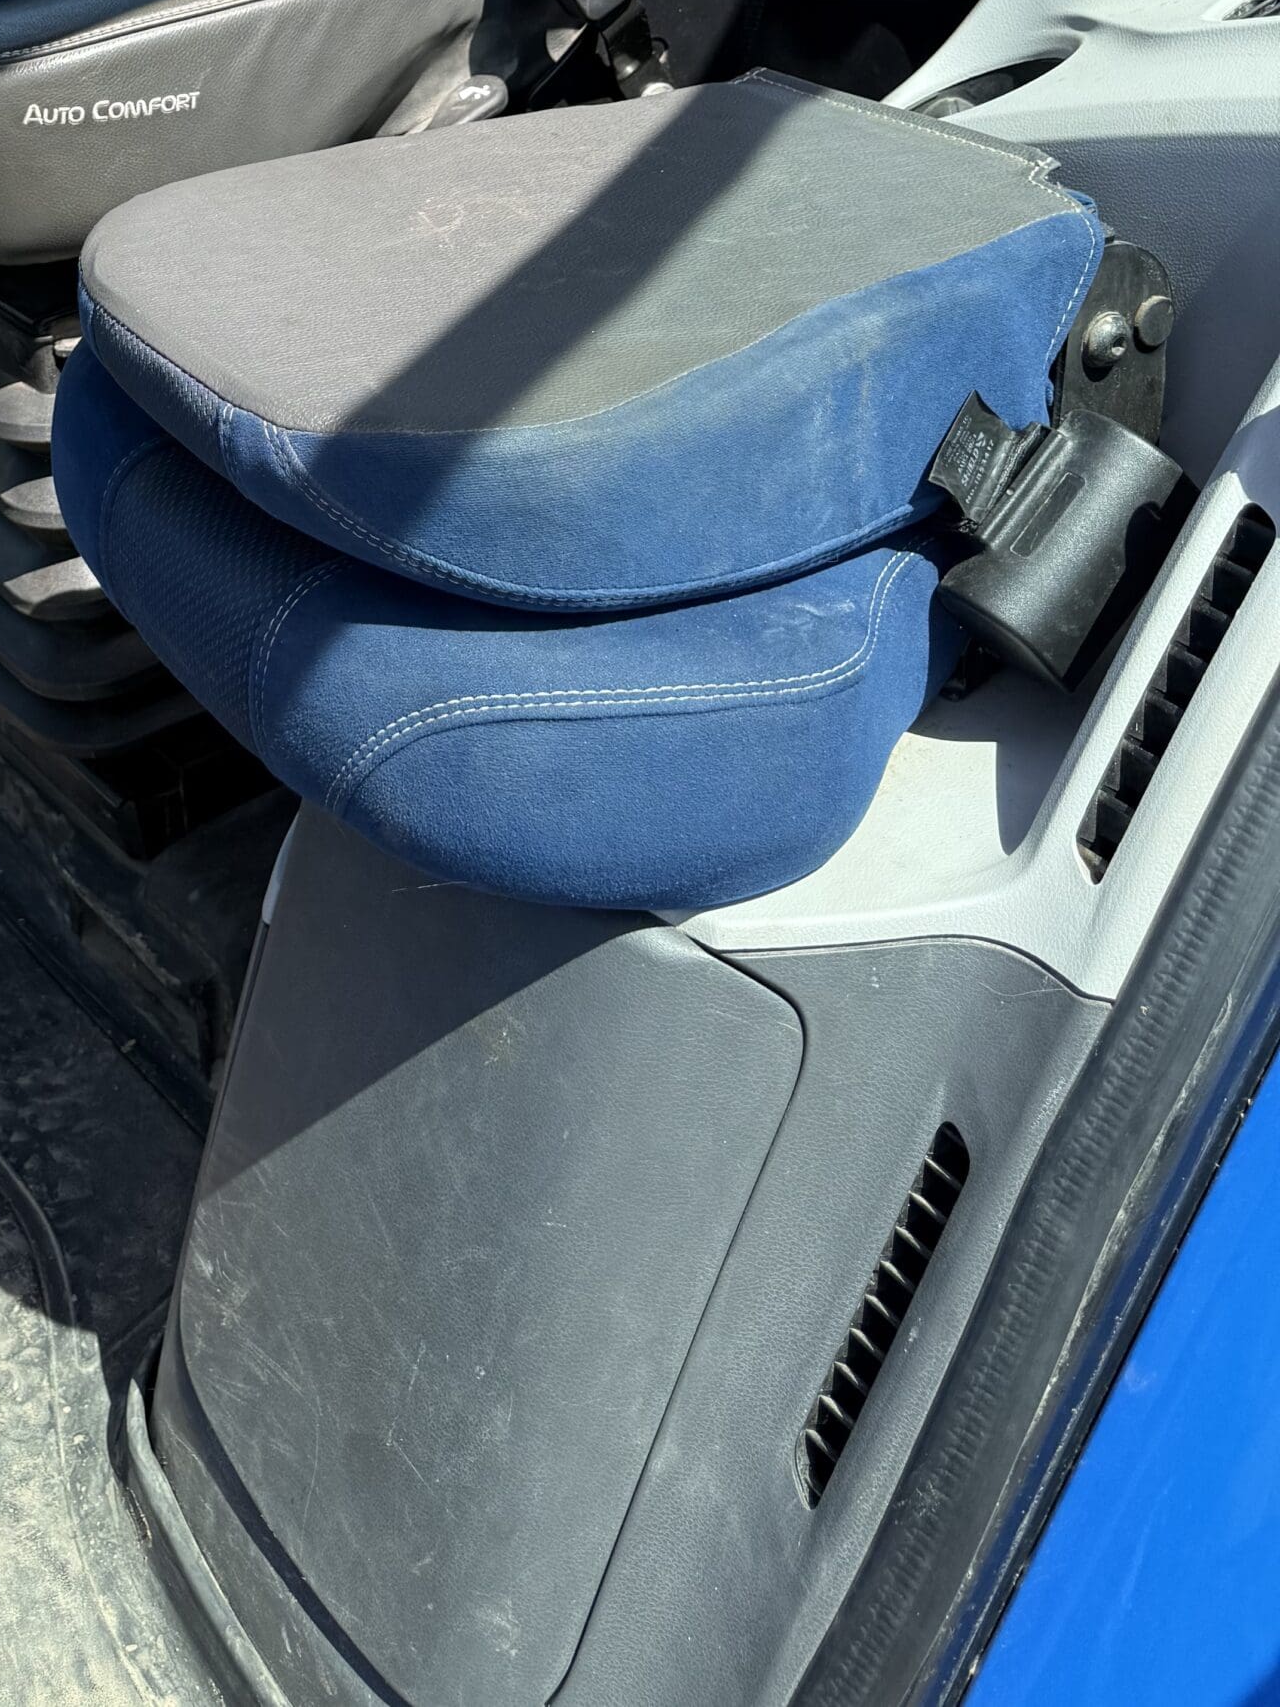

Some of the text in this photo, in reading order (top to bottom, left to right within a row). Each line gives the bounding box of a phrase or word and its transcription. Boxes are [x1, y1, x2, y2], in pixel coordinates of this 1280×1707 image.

[23, 91, 200, 125] AUTO COMFORT
[961, 447, 979, 487] SHIELD
